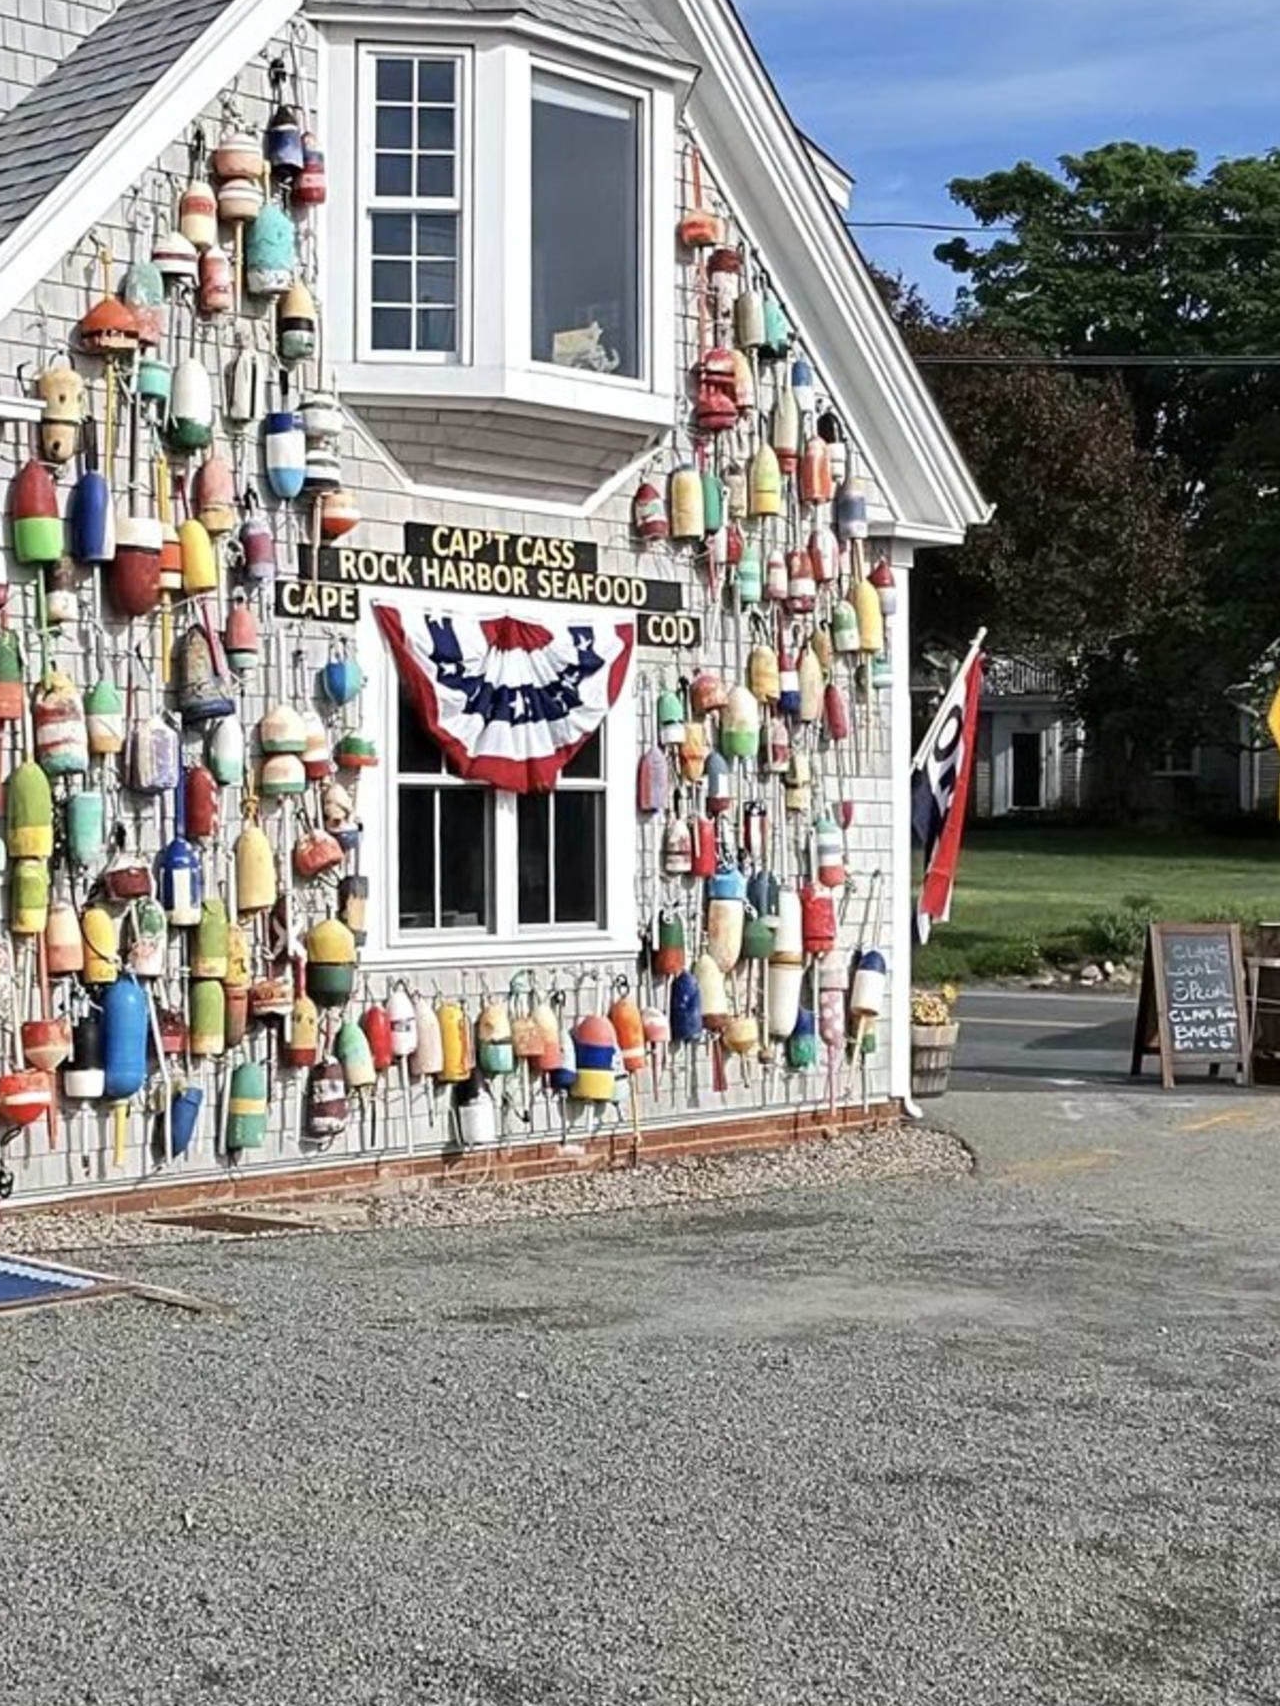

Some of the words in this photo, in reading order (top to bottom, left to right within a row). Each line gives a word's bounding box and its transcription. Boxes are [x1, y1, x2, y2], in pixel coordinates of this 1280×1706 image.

[432, 526, 510, 564] CAP'T
[516, 536, 576, 568] CASS
[339, 549, 413, 586] ROCK
[422, 558, 529, 597] HARBOR
[536, 570, 647, 606] SEAFOOD
[283, 585, 356, 620] CAPE
[646, 615, 695, 646] COD
[1168, 1009, 1214, 1023] CLAM
